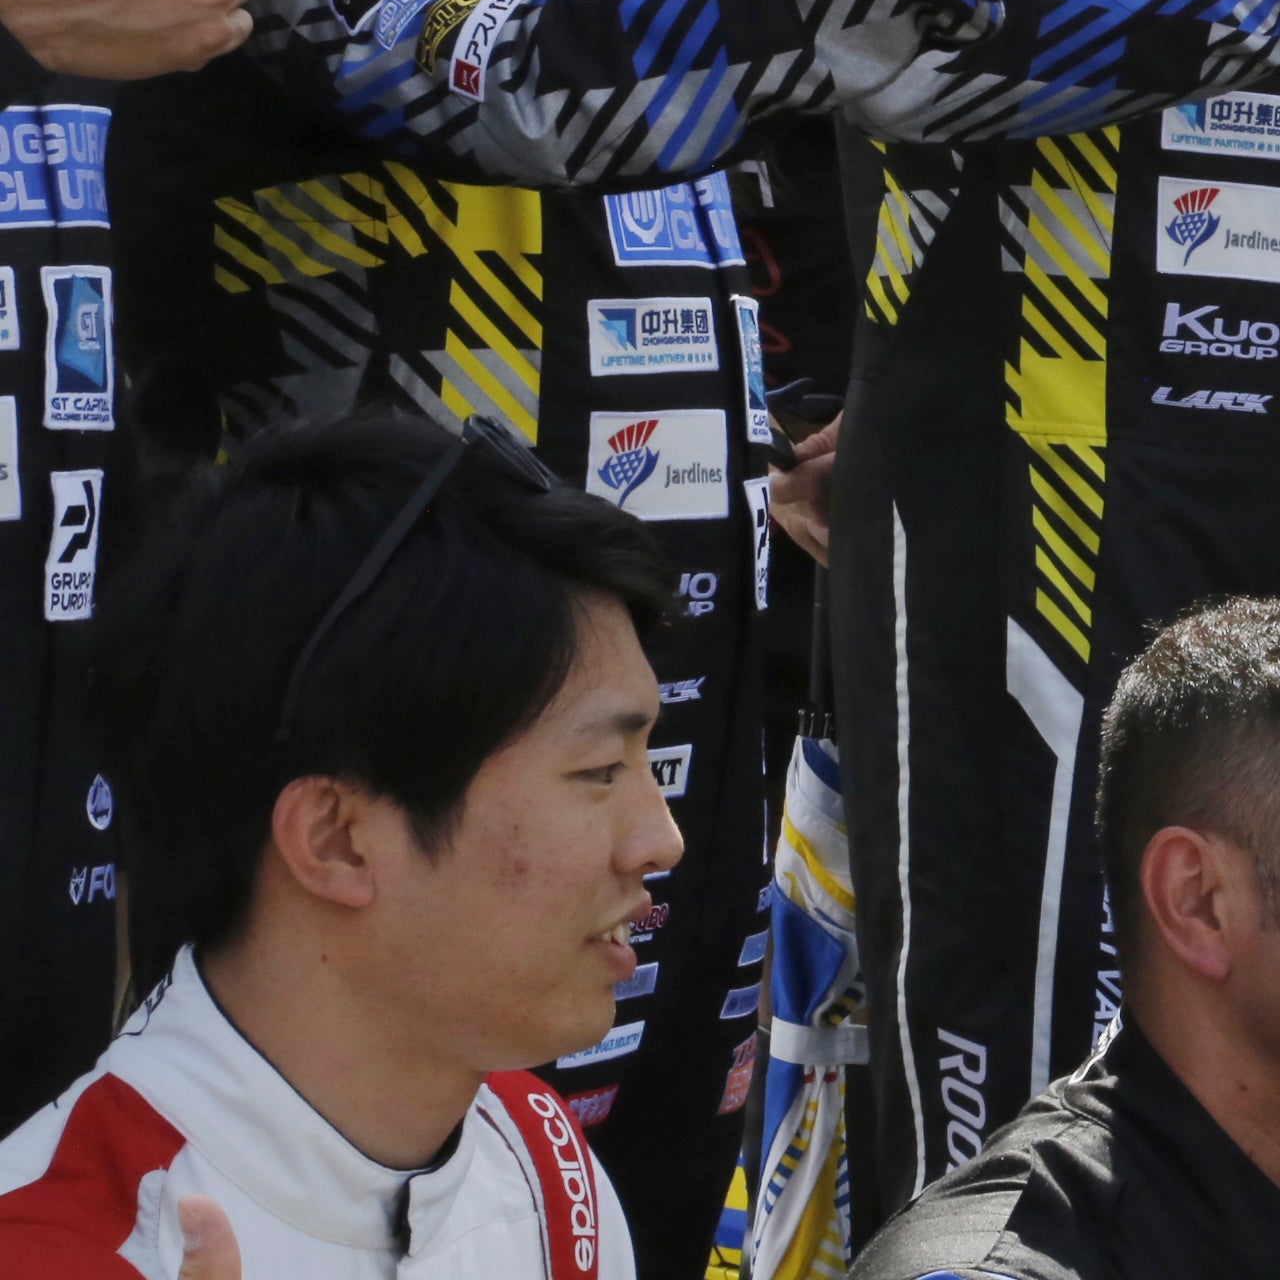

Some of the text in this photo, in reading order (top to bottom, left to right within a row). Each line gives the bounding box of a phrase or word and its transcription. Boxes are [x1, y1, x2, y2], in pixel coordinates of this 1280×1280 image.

[641, 309, 709, 336] 中升集团
[1159, 339, 1279, 360] GROUP
[526, 1091, 594, 1273] sparco
